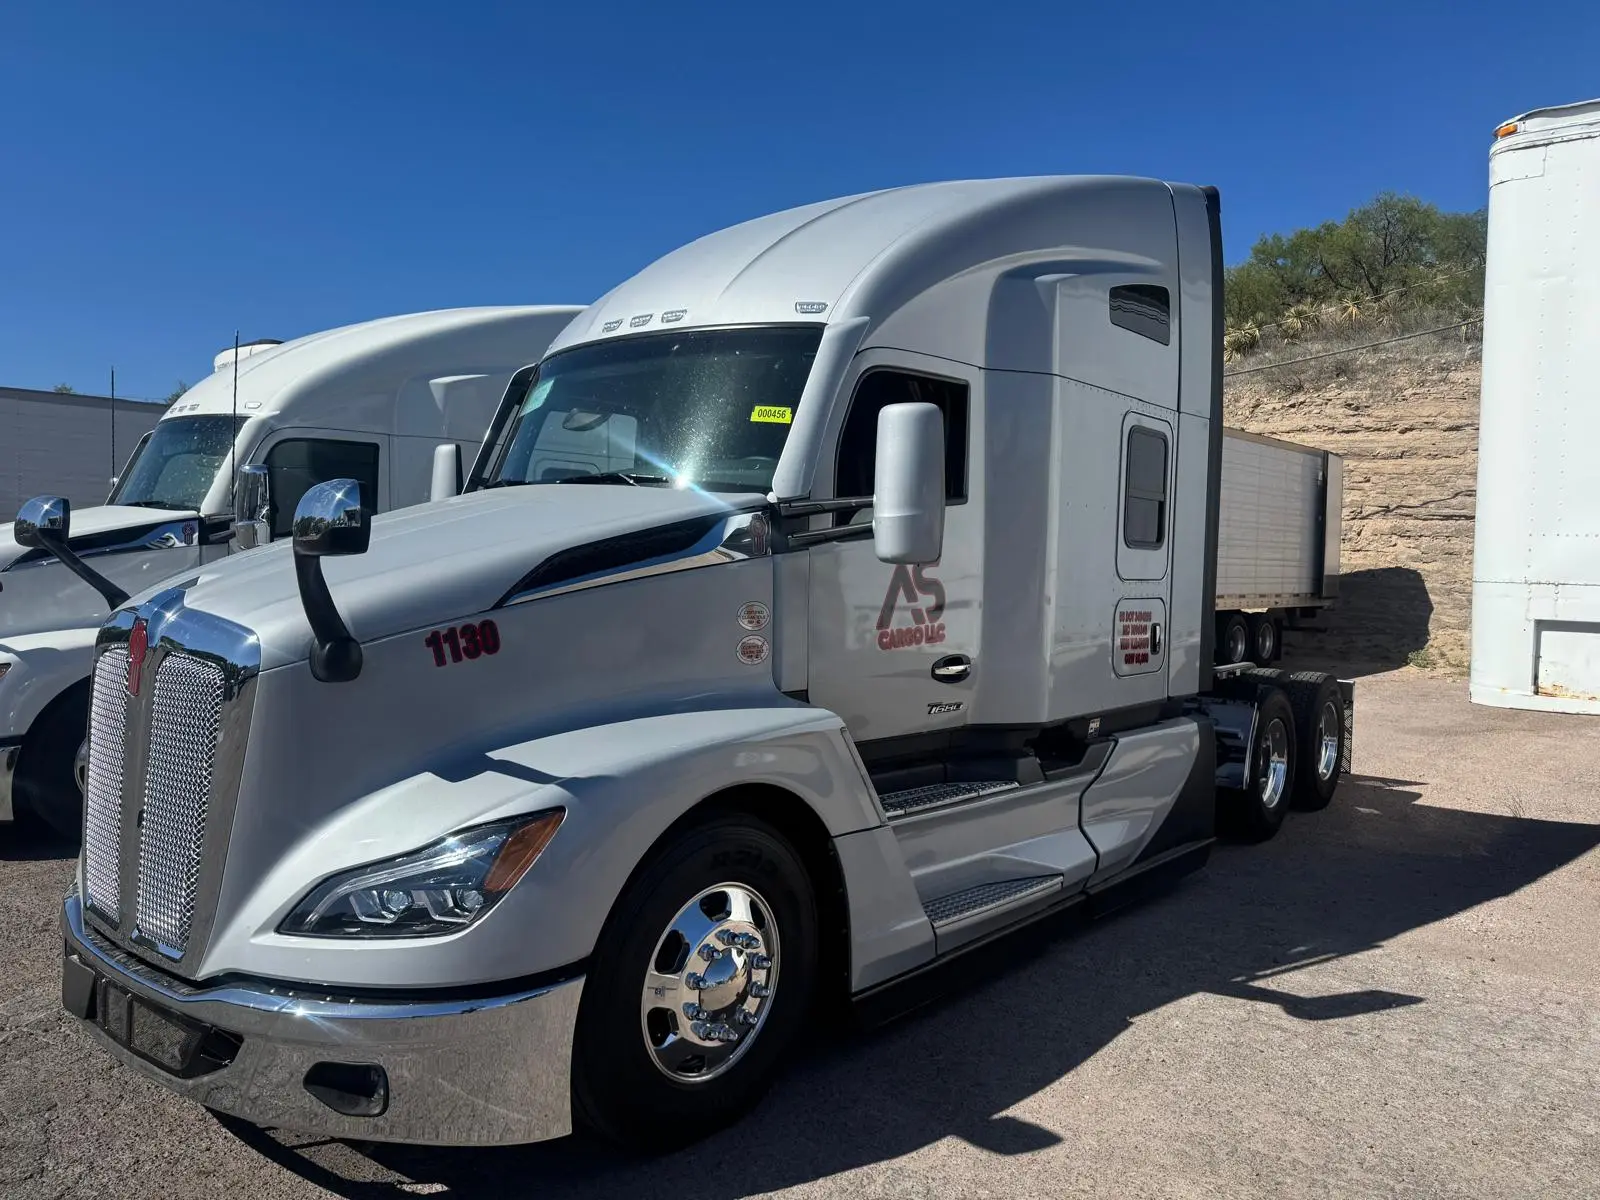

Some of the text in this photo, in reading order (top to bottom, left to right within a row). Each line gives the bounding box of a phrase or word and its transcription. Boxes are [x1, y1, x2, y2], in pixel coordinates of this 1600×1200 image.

[757, 409, 787, 419] 000456
[875, 562, 946, 631] AS
[424, 618, 501, 667] 1130
[877, 622, 946, 651] CARGO LLC
[927, 702, 964, 714] T680
